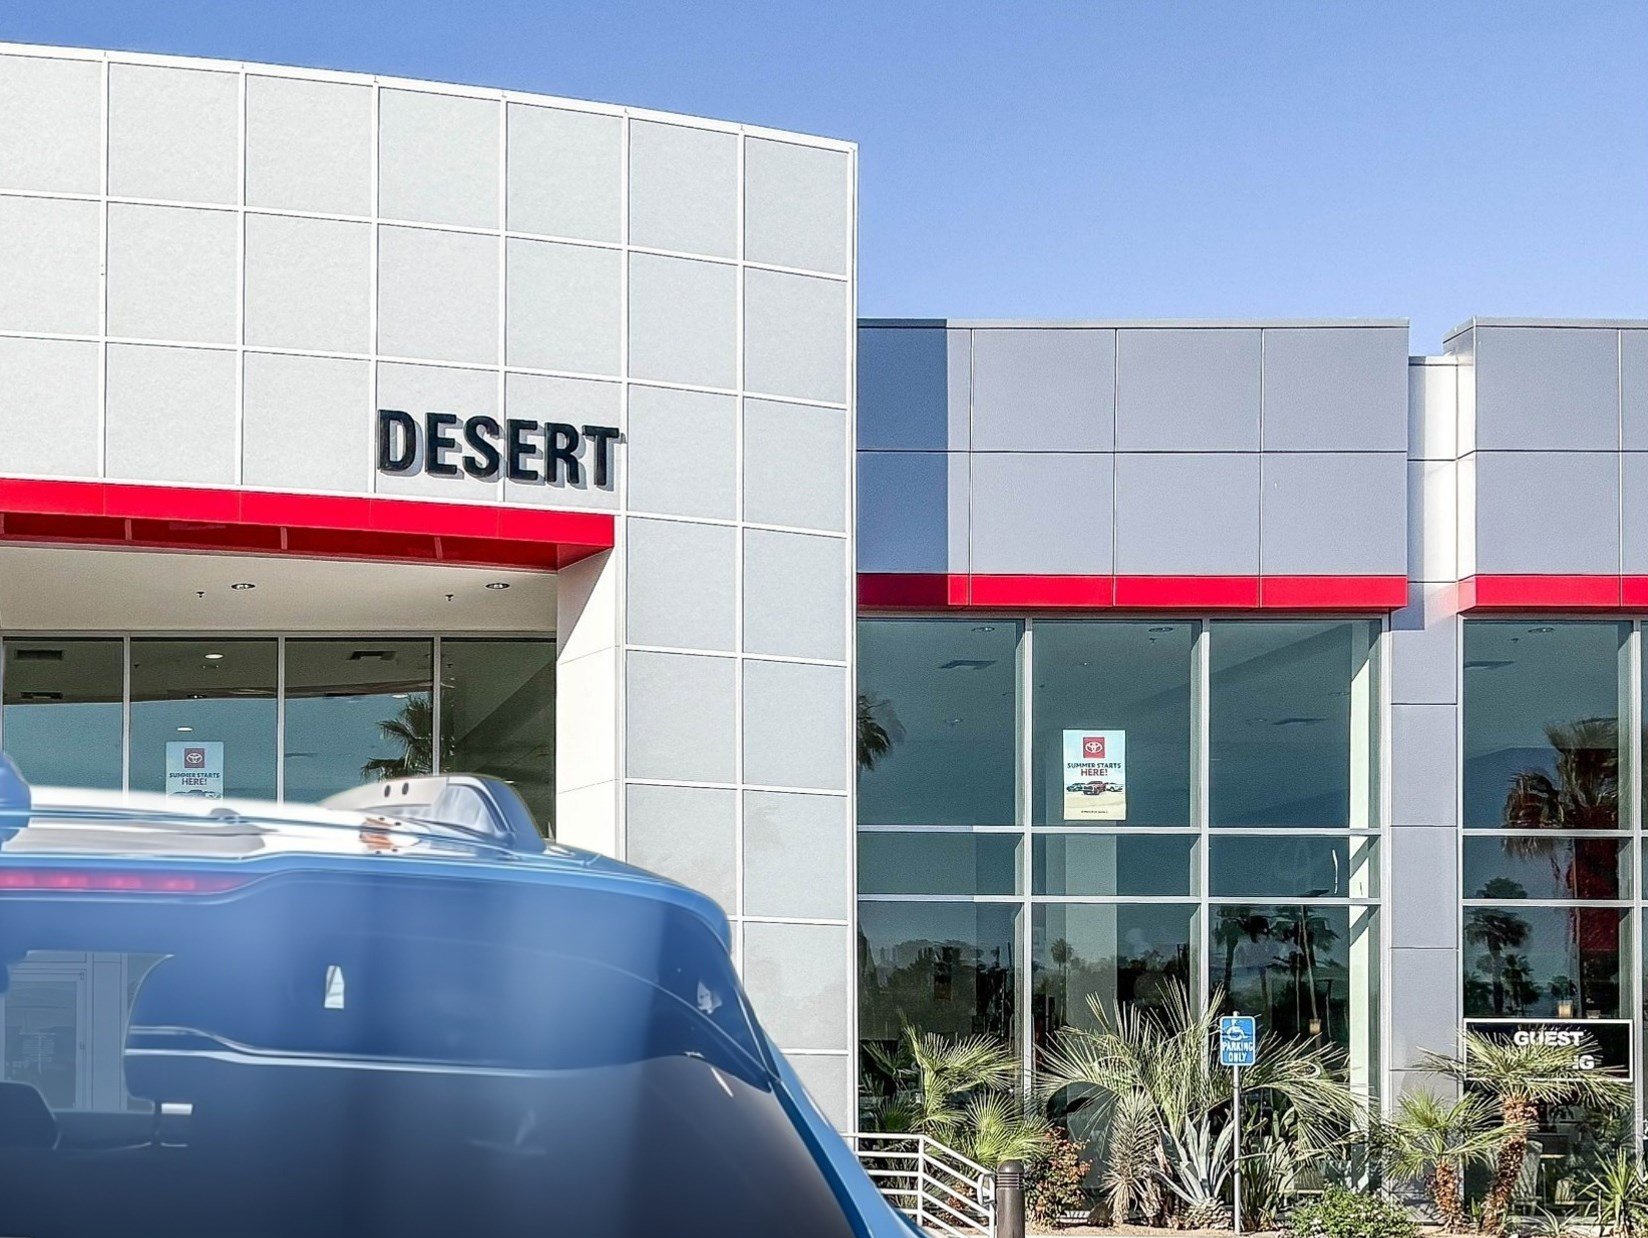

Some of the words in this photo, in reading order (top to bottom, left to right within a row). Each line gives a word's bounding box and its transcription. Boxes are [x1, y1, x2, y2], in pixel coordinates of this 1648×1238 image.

[377, 409, 620, 487] DESERT
[1080, 769, 1108, 777] HERE!
[181, 778, 207, 786] HERE!
[1513, 1031, 1585, 1047] GUEST
[1222, 1041, 1254, 1052] PARKING
[1228, 1051, 1248, 1062] ONLY
